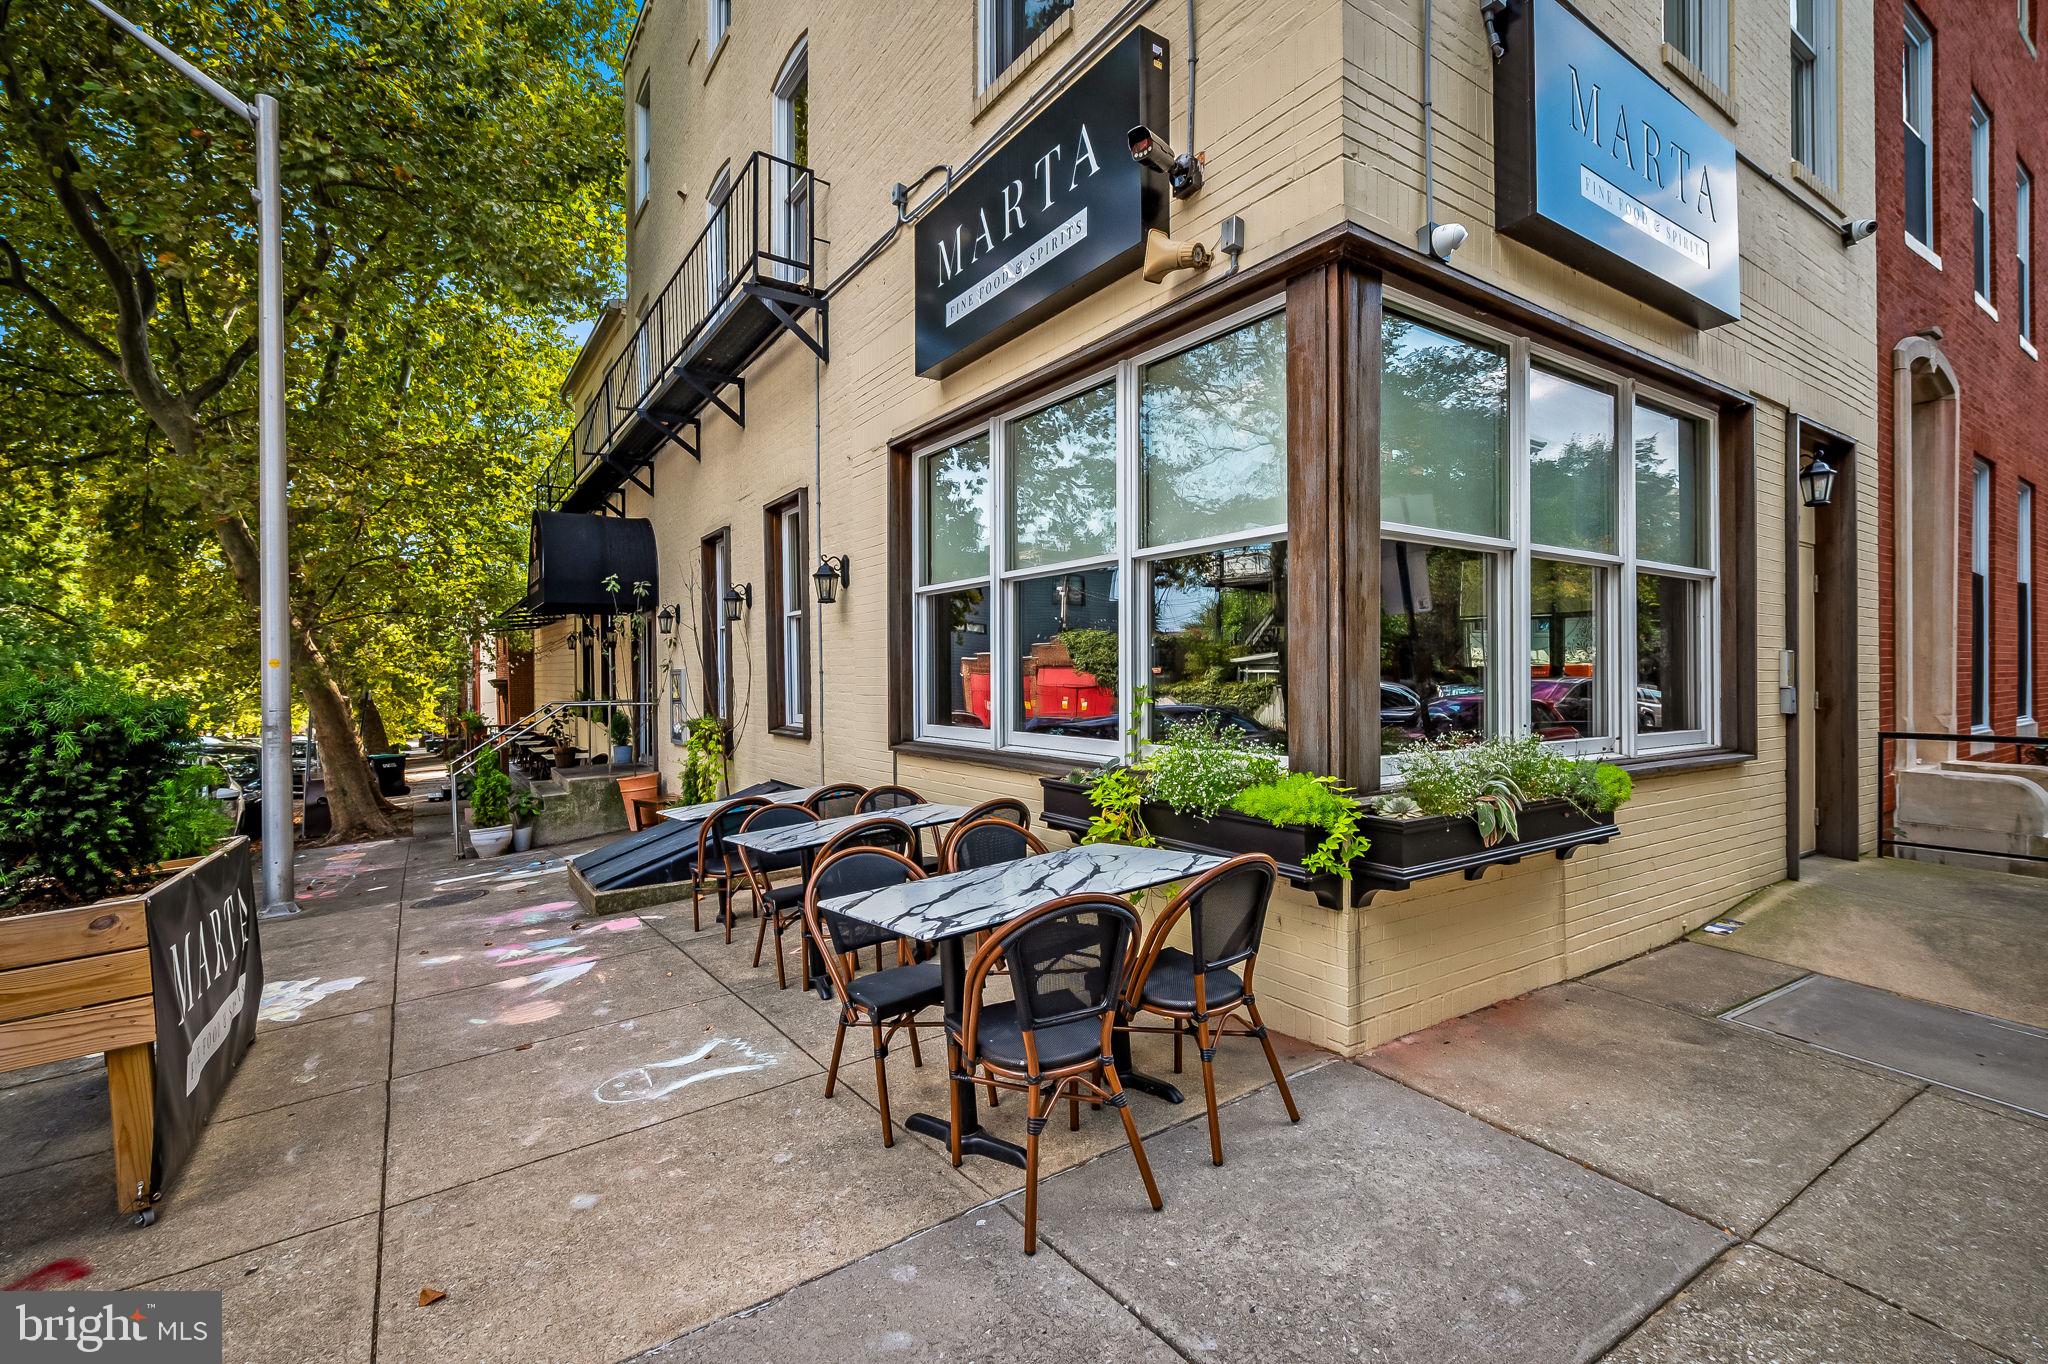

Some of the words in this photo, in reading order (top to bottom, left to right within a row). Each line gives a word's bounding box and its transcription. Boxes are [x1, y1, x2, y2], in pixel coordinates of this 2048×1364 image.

[937, 123, 1101, 288] MARTA
[1567, 63, 1717, 223] MARTA
[949, 293, 974, 319] FINE
[979, 269, 1010, 301] FOOD
[1015, 260, 1024, 275] &
[1029, 219, 1083, 266] SPIRITS
[1585, 176, 1613, 206] FINE
[1618, 196, 1649, 226] FOOD
[1665, 225, 1706, 257] SPIRITS
[170, 887, 249, 1026] MARTA
